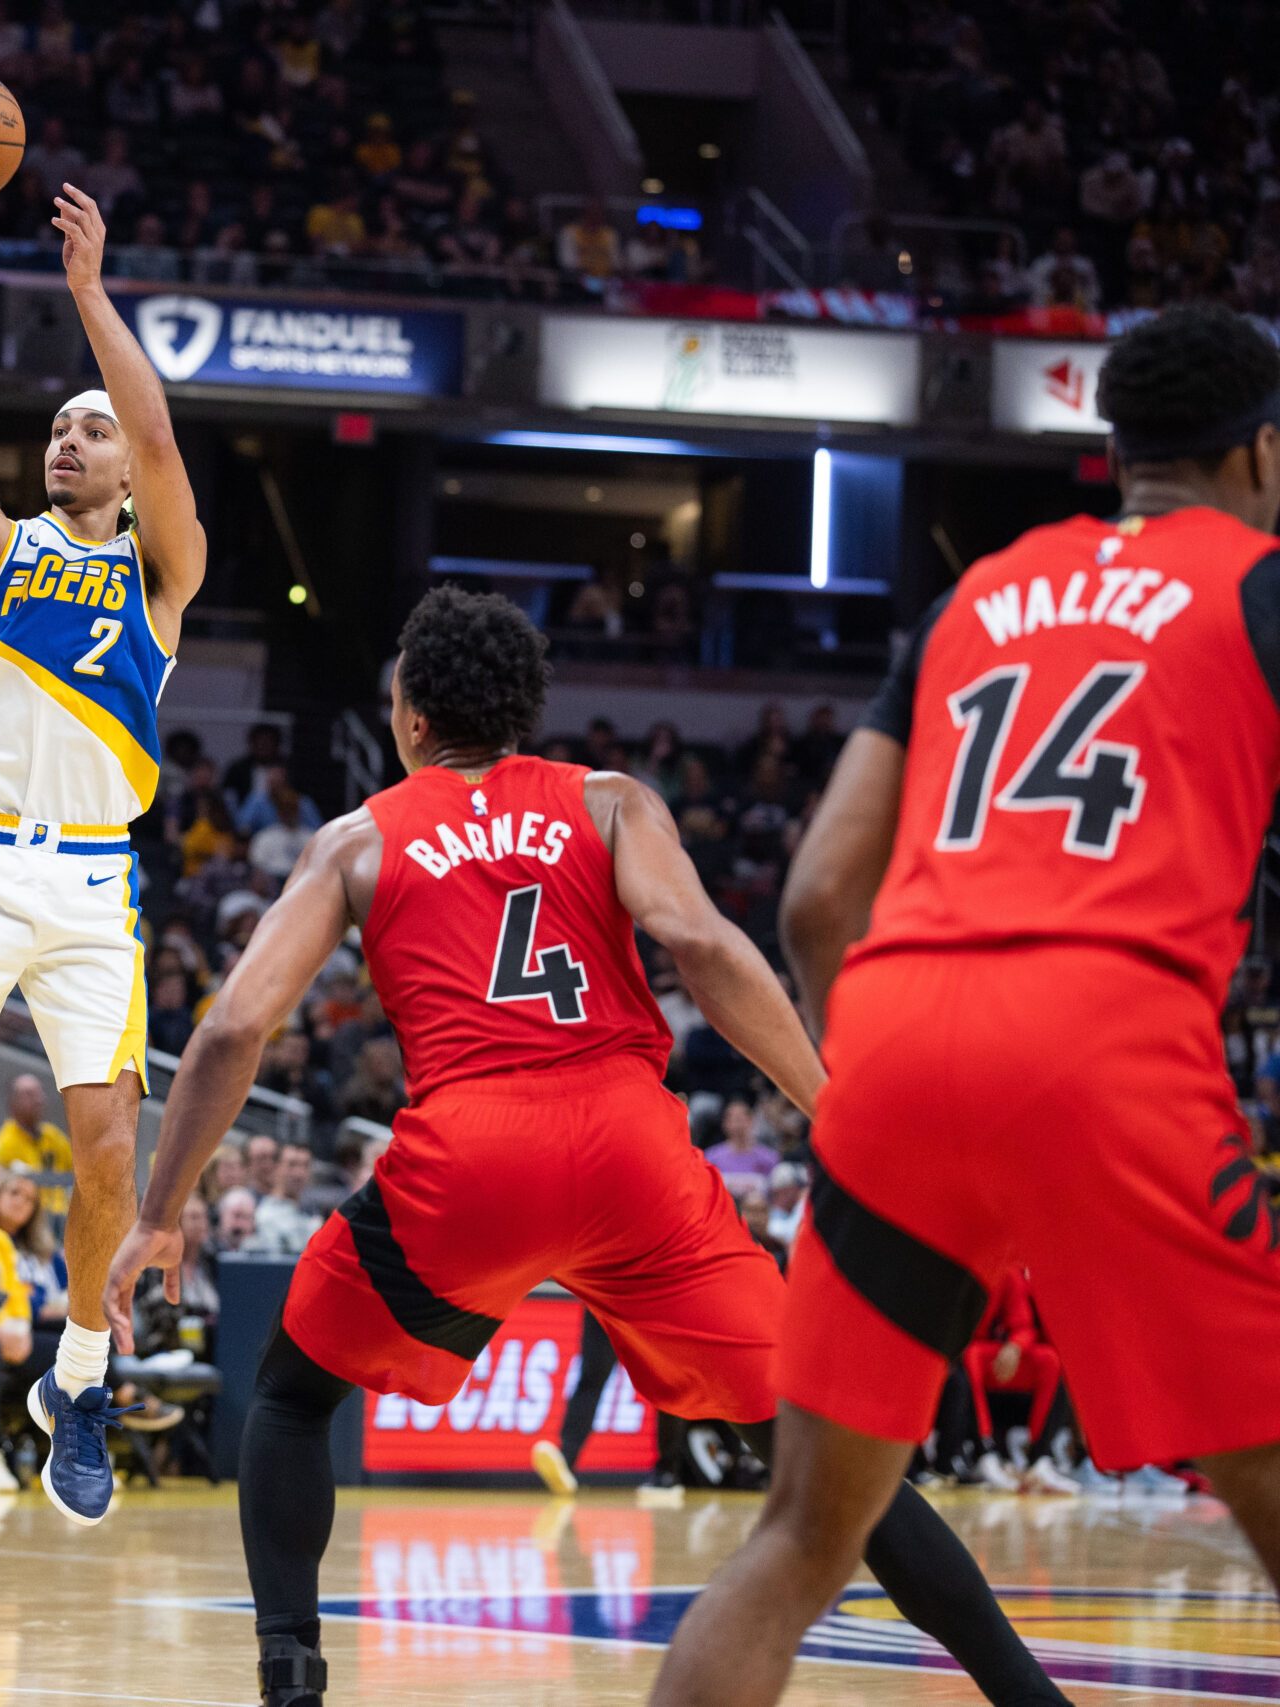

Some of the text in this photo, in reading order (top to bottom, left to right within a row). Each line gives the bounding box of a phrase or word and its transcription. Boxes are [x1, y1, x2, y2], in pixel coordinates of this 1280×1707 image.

[230, 308, 415, 357] FANDUEL
[73, 617, 123, 676] 2
[973, 566, 1194, 647] WALTER
[933, 660, 1148, 862] 14
[404, 811, 573, 880] BARNES
[485, 882, 590, 1025] 4
[373, 1338, 559, 1434] CAS
